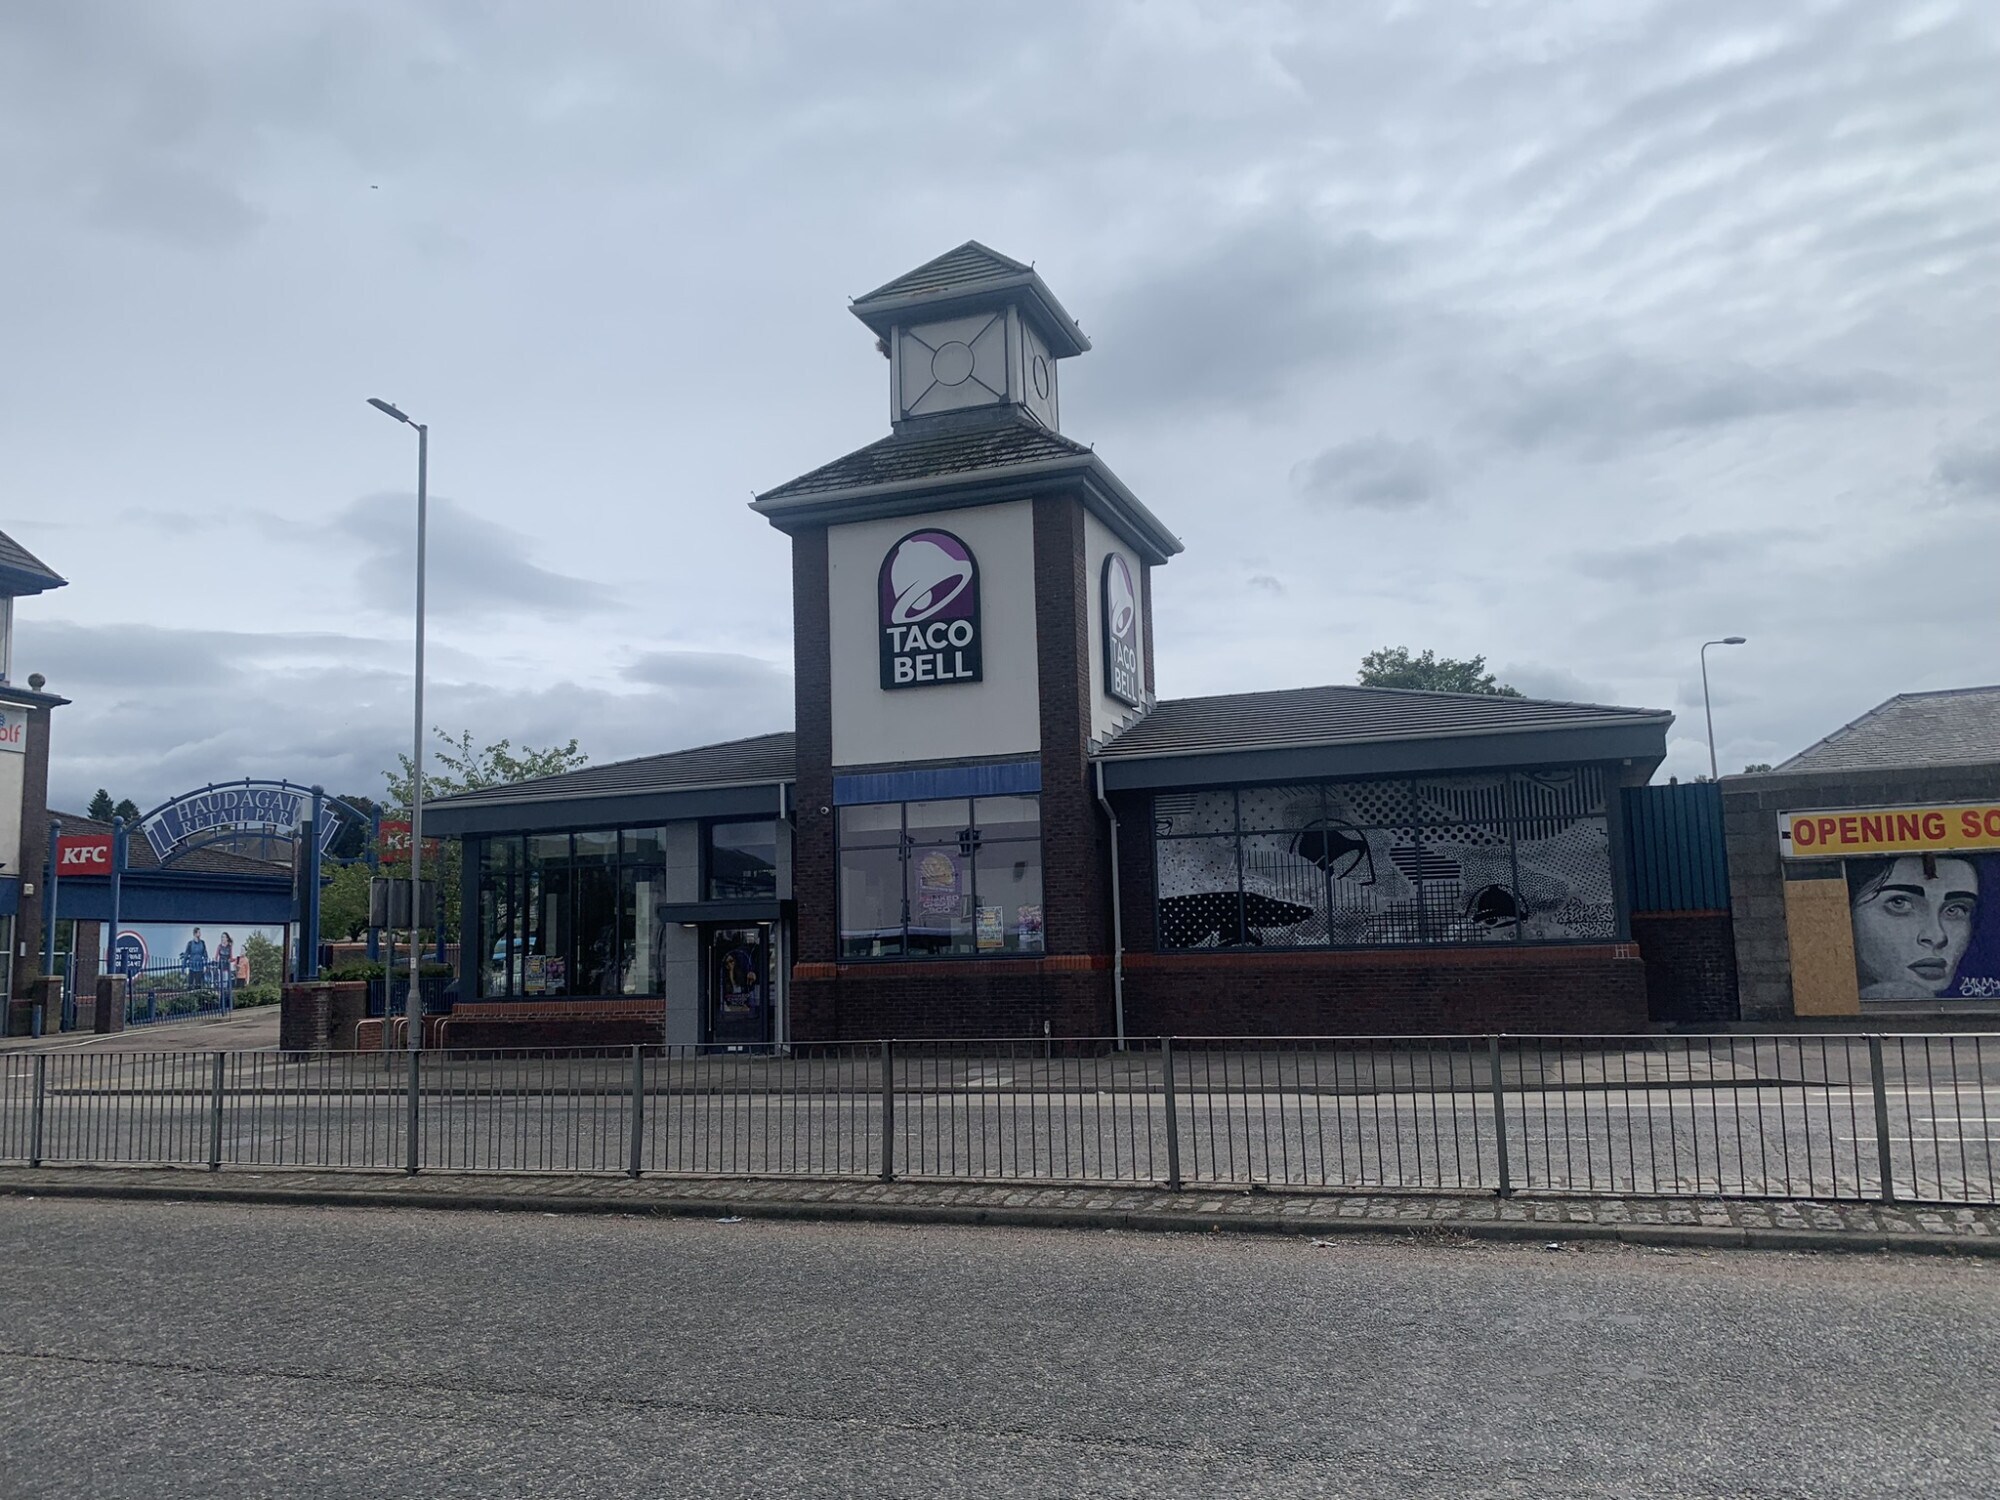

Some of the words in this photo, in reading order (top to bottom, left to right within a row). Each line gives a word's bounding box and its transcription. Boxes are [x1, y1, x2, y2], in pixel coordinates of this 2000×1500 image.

[886, 619, 974, 653] TACO
[894, 651, 973, 684] BELL
[1111, 636, 1137, 674] TACO
[1114, 666, 1138, 702] BELL
[181, 810, 249, 835] RETAIL
[255, 808, 297, 828] PAR
[1793, 813, 1946, 846] OPENING
[61, 846, 107, 864] KFC
